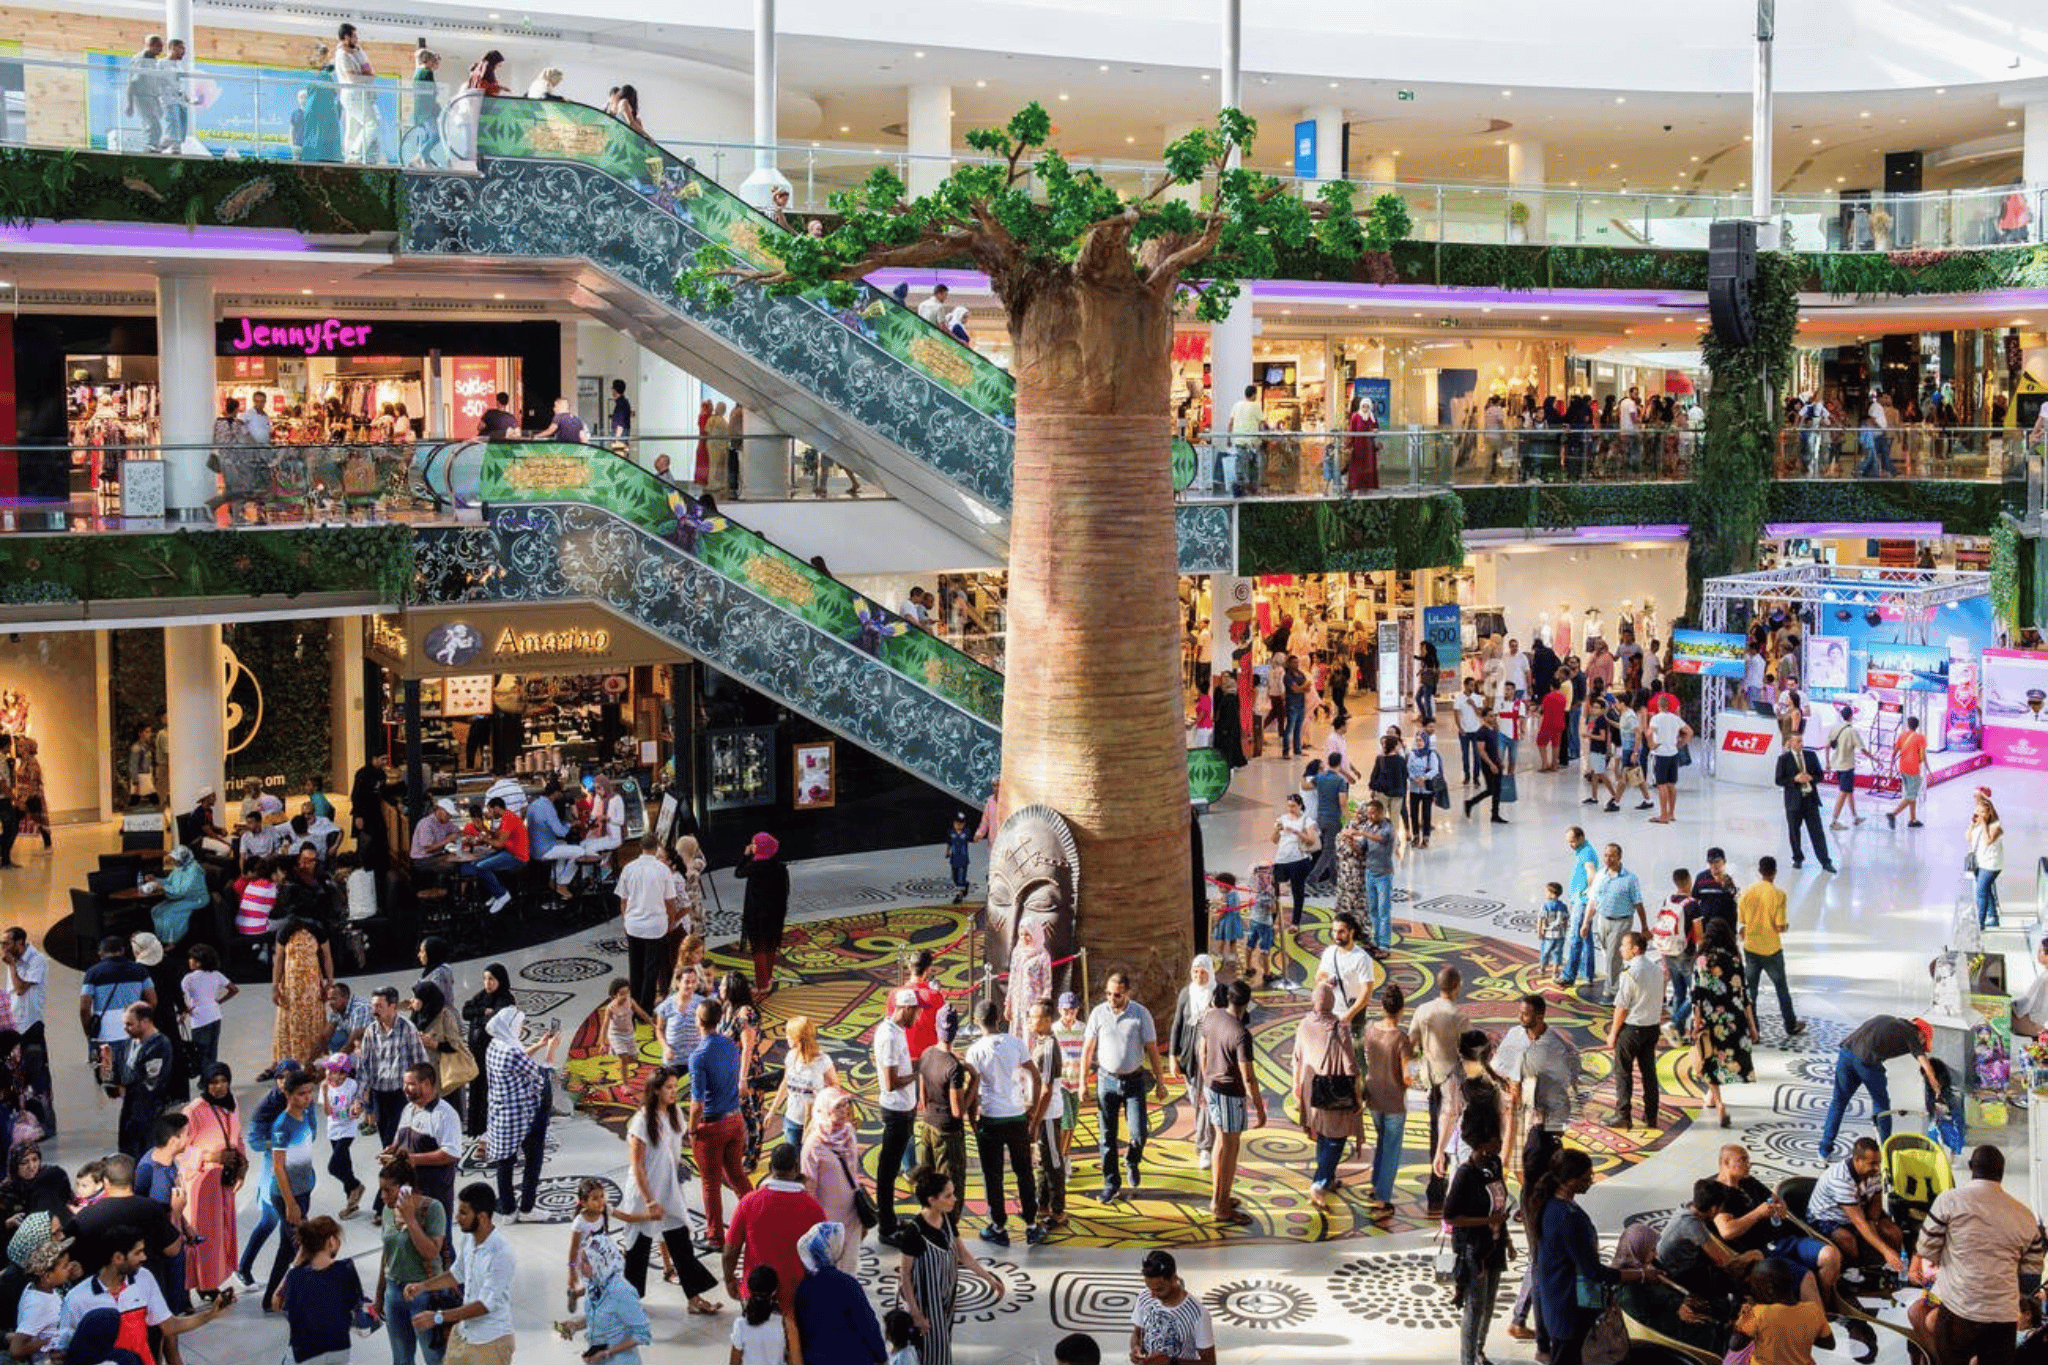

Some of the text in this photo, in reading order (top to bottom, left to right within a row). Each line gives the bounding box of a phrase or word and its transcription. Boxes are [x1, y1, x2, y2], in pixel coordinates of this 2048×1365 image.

[233, 317, 372, 354] Jennyfer
[1429, 628, 1457, 644] 500
[1731, 737, 1759, 749] kti
